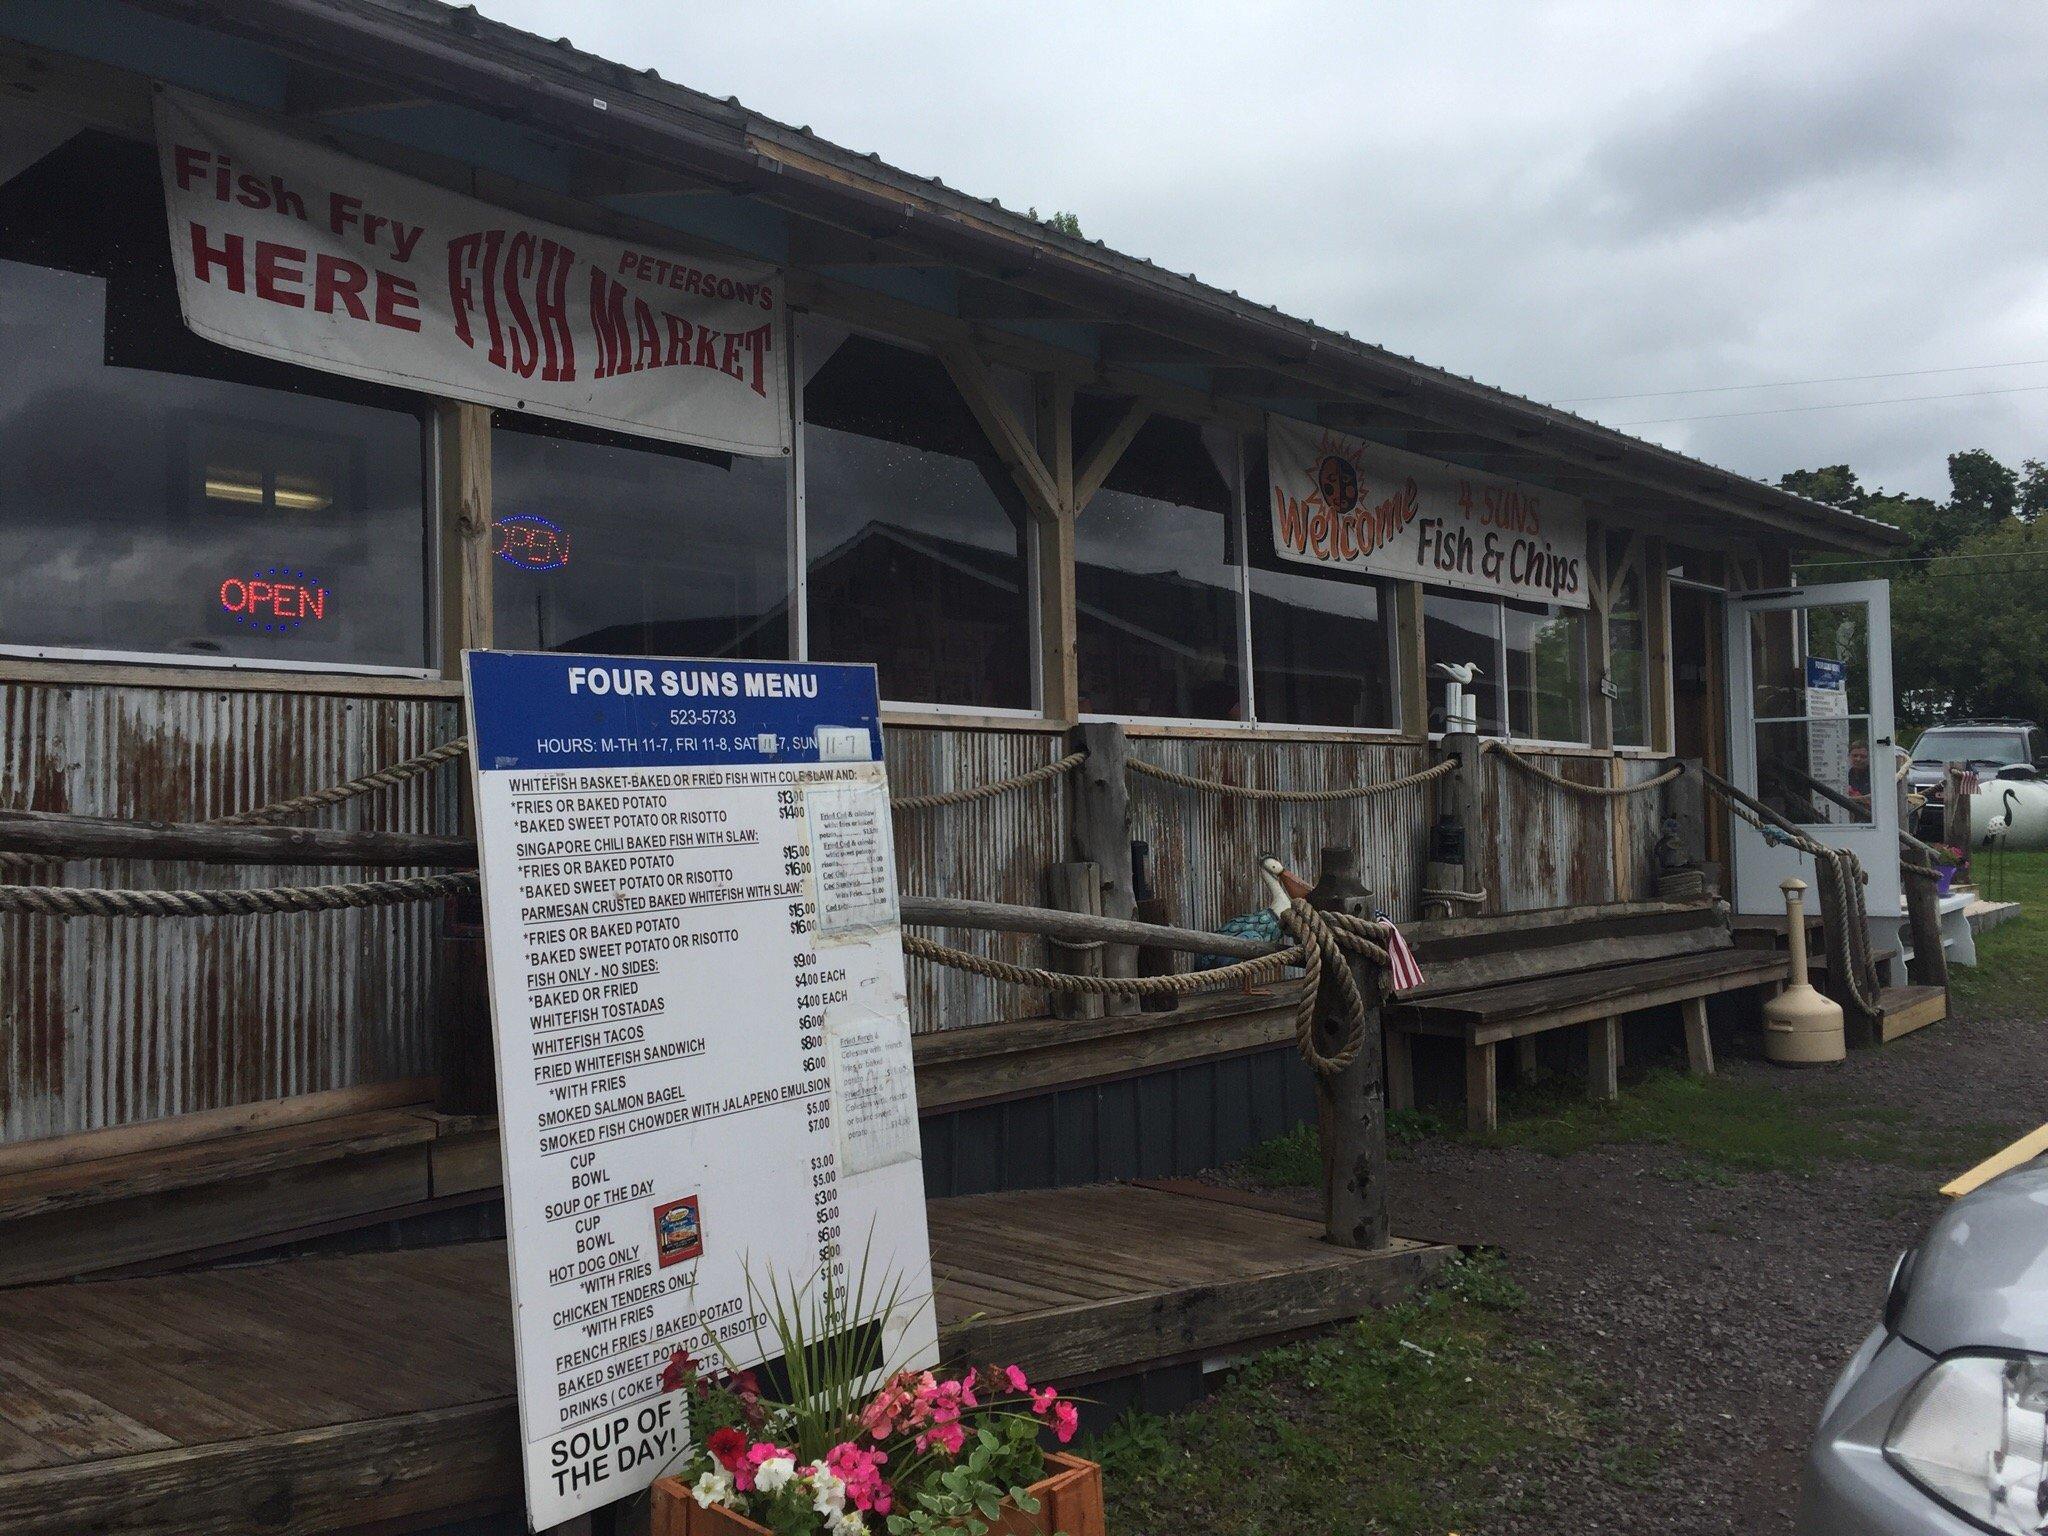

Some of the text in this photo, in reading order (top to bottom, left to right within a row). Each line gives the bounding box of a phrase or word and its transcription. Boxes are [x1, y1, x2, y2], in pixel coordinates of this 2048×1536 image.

[174, 144, 426, 263] Fish Fry
[190, 220, 422, 334] HERE
[617, 250, 774, 312] PETERSON'S
[447, 228, 773, 400] FISH MARKET
[1458, 480, 1473, 520] 4
[1275, 475, 1419, 562] Welcome
[1417, 517, 1580, 598] Fish & Chips
[220, 578, 324, 620] OPEN
[568, 667, 818, 699] FOUR SUNS MENU
[670, 709, 737, 725] 523-5733
[537, 738, 597, 754] HOURS:
[601, 737, 638, 752] M-TH
[642, 738, 673, 754] 11-7,
[676, 737, 698, 751] FRI
[702, 737, 731, 752] 11-8,
[734, 737, 758, 751] SAT
[793, 736, 818, 750] SUN
[509, 777, 577, 792] WHITEFISH
[581, 774, 671, 790] BASKET-BAKED
[674, 773, 690, 787] OR
[692, 773, 723, 786] FRIED
[725, 772, 749, 785] FISH
[751, 771, 776, 784] WITH
[836, 769, 857, 781] AND:
[556, 799, 574, 812] OR
[578, 797, 619, 811] BAKED
[623, 795, 667, 808] POTATO
[568, 816, 610, 831] SWEET
[613, 814, 659, 828] POTATO
[661, 812, 677, 826] OR
[681, 810, 727, 824] RISOTTO
[516, 829, 759, 857] SINGAPORE CHILI BAKED FISH WITH SLAW:
[563, 861, 581, 875] OR
[585, 858, 627, 874] BAKED
[630, 854, 674, 870] POTATO
[573, 879, 616, 895] SWEET
[619, 874, 664, 891] POTATO
[667, 873, 683, 886] OR
[686, 869, 733, 884] RISOTTO
[521, 884, 803, 922] PARMESAN CRUSTED BAKED WHITEFISH WITH SLAW:
[569, 927, 587, 941] OR
[591, 922, 633, 939] BAKED
[636, 916, 680, 933] POTATO
[579, 943, 622, 960] SWEET
[625, 937, 670, 955] POTATO
[673, 935, 689, 948] OR
[692, 929, 738, 946] RISOTTO
[527, 973, 556, 988] FISH
[559, 967, 591, 984] ONLY
[601, 964, 619, 978] NO
[622, 958, 659, 975] SIDES:
[821, 969, 846, 983] EACH
[583, 988, 600, 1001] OR
[604, 981, 639, 998] FRIED
[822, 990, 847, 1004] EACH
[530, 997, 665, 1030] WHITEFISH TOSTADAS
[532, 1025, 644, 1056] WHITEFISH TACOS
[534, 1038, 705, 1081] FRIED WHITEFISH SANDWICH
[591, 1076, 626, 1093] FRIES
[538, 1086, 685, 1128] SMOKED SALMON BAGEL
[540, 1128, 595, 1153] SMOKED
[599, 1121, 625, 1139] FISH
[629, 1108, 689, 1133] CHOWDER
[692, 1100, 720, 1118] WITH
[722, 1088, 779, 1112] JALAPENO
[781, 1077, 830, 1098] EMULSION
[807, 1099, 830, 1116] $5.00
[808, 1117, 830, 1133] $7.00
[570, 1152, 596, 1169] CUP
[811, 1153, 834, 1170] $3.00
[572, 1169, 610, 1190] BOWL
[813, 1170, 836, 1187] $5.00
[545, 1179, 655, 1220] SOUP OF THE DAY
[575, 1215, 601, 1234] CUP
[576, 1232, 615, 1254] BOWL
[549, 1245, 640, 1284] HOT DOG ONLY
[619, 1263, 652, 1283] FRIES
[552, 1270, 697, 1327] CHICKEN TENDERS ONLY
[620, 1304, 654, 1326] FRIES
[555, 1343, 608, 1372] FRENCH
[612, 1330, 647, 1352] FRIES
[656, 1313, 697, 1336] BAKED
[700, 1297, 742, 1321] POTATO
[558, 1370, 604, 1397] BAKED
[607, 1352, 650, 1380] SWEET
[720, 1312, 767, 1340] RISOTTO
[560, 1397, 607, 1422] DRINKS
[552, 1401, 672, 1468] SOUP OF
[552, 1428, 677, 1497] THE DAY!
